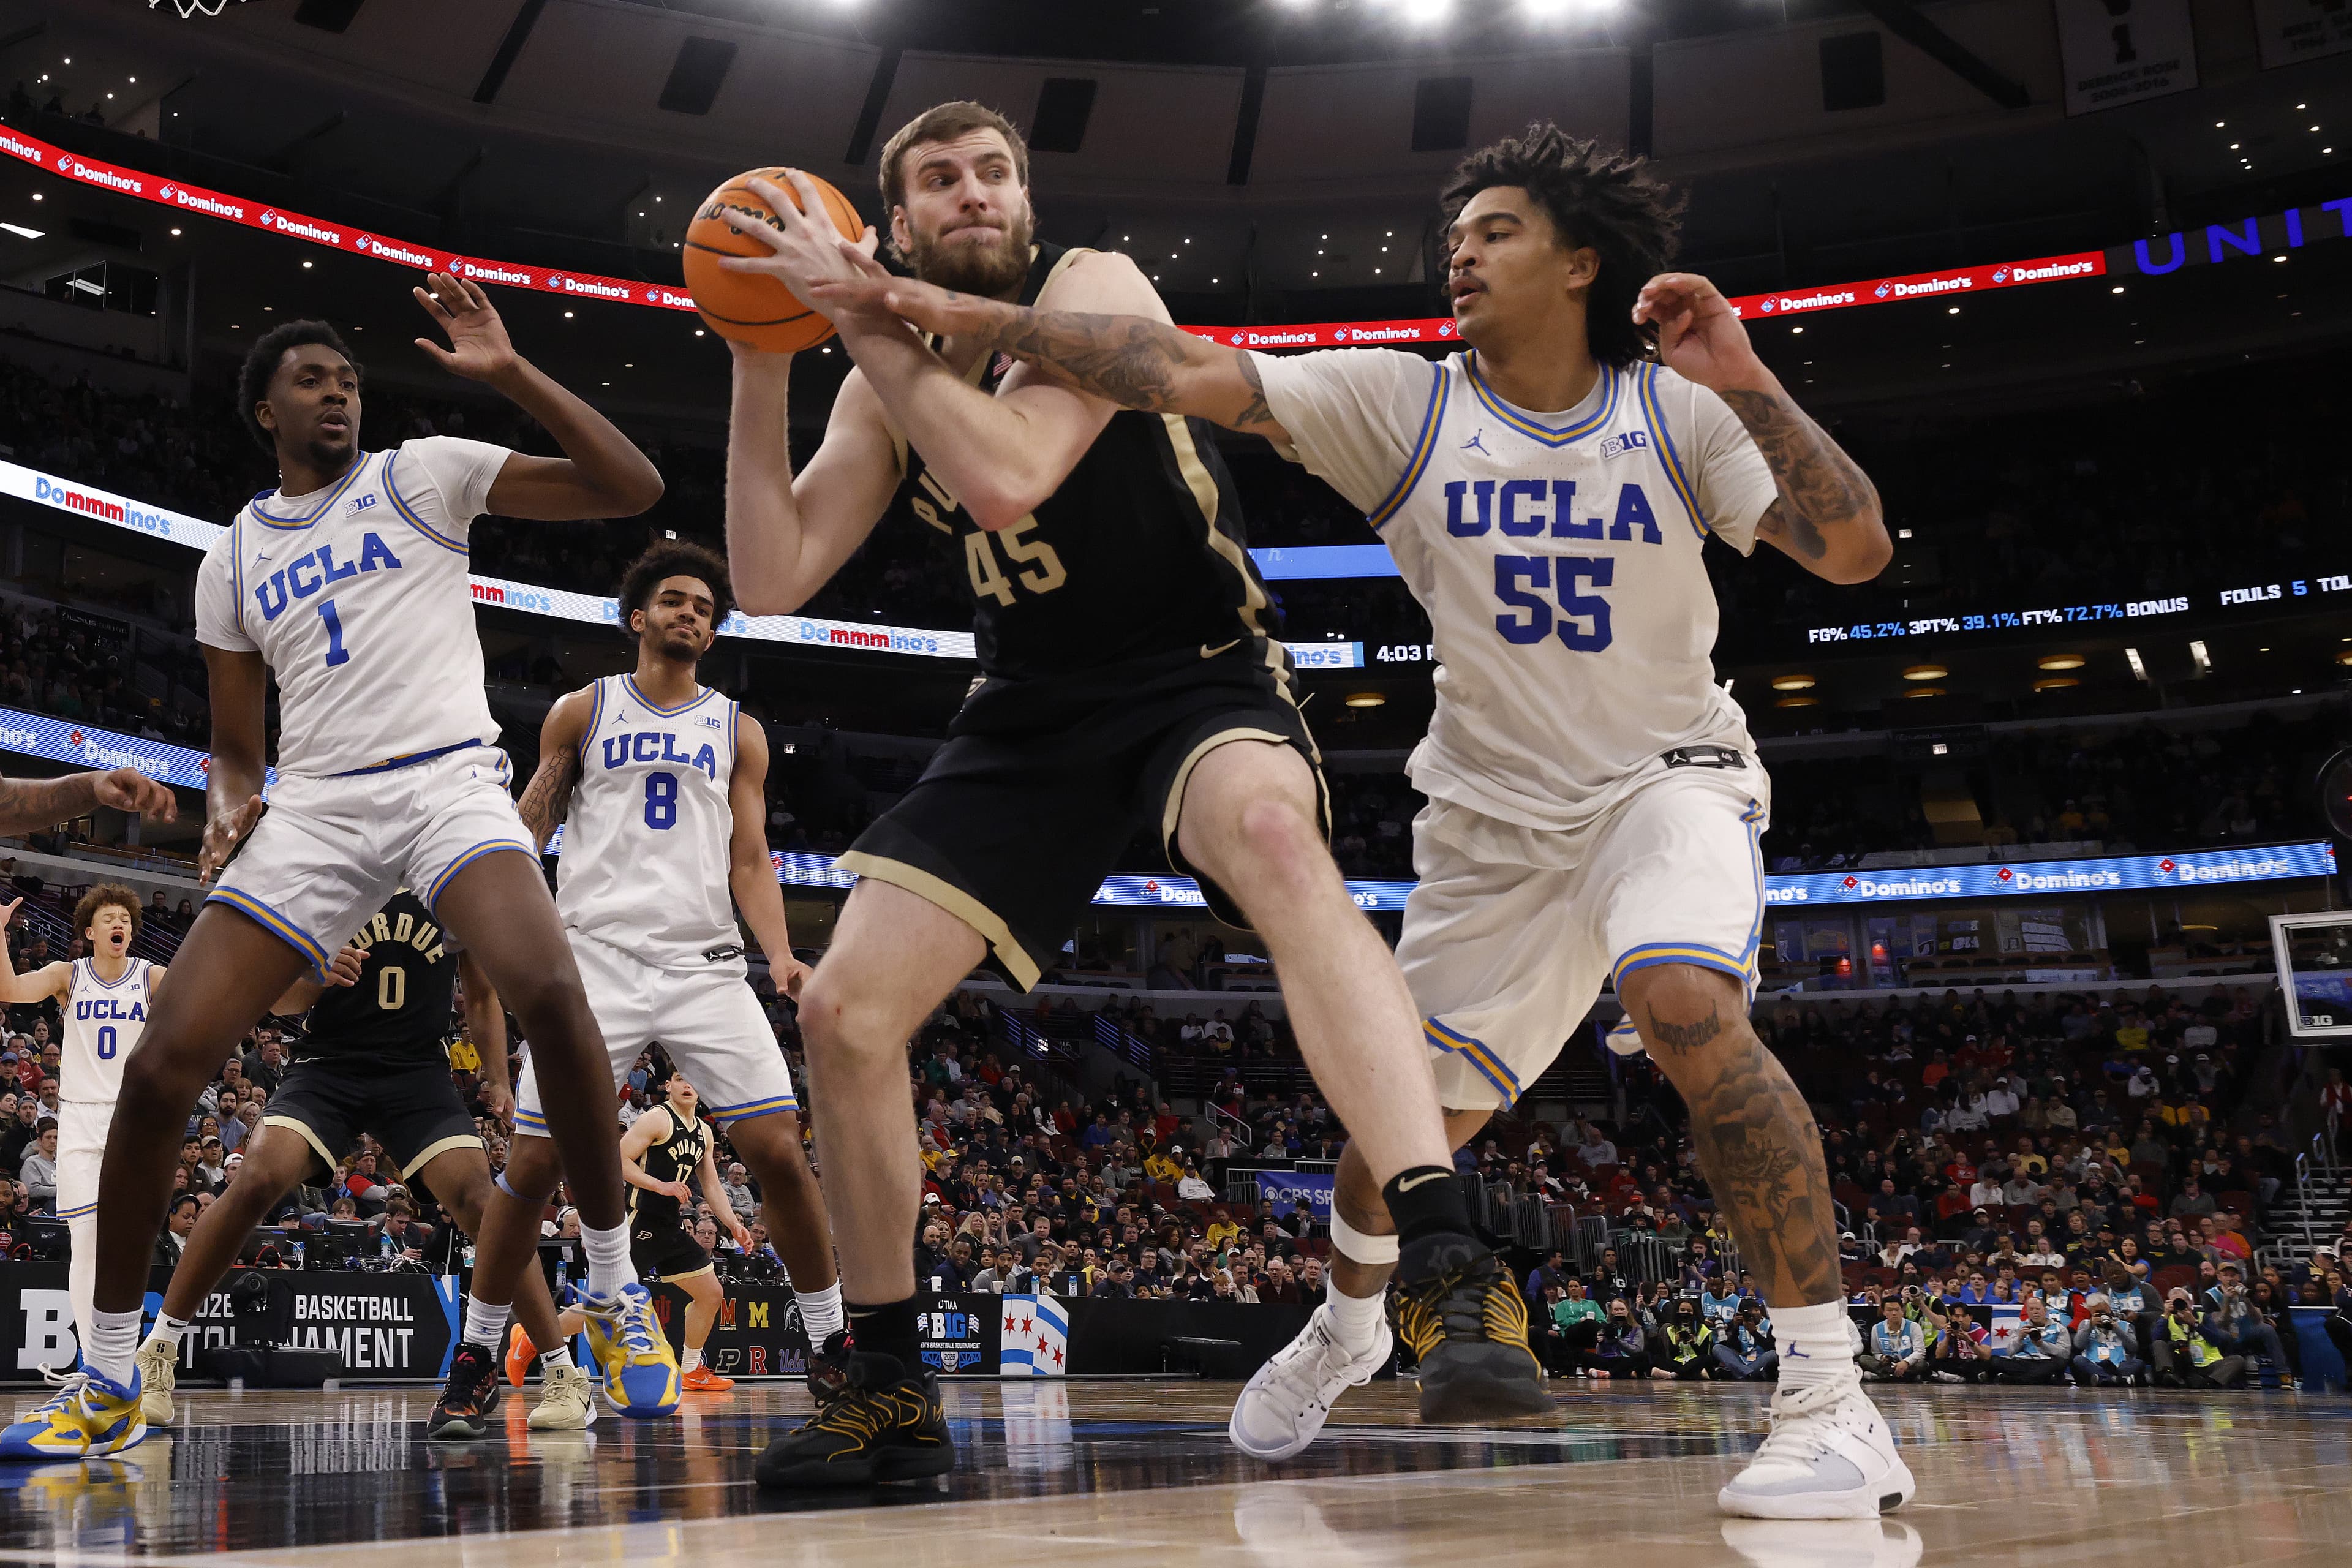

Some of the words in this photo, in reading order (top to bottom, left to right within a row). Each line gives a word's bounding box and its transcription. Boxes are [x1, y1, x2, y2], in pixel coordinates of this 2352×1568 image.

[74, 162, 142, 193] Domino's
[178, 190, 243, 219] Domino's
[277, 216, 340, 244] Domino's
[372, 241, 432, 268] Domino's
[465, 263, 531, 285] Domino's
[2013, 260, 2094, 282] Domino's
[565, 277, 630, 299] Domino's
[1894, 276, 1972, 298] Domino's
[1780, 291, 1855, 311] Domino's
[1249, 332, 1317, 345] Domino's
[1352, 328, 1420, 341] Domino's
[35, 476, 172, 535] Dommmino's
[1444, 480, 1663, 545] UCLA
[964, 512, 1068, 608] 45
[255, 532, 402, 622] UCLA
[1494, 554, 1615, 653] 55
[2220, 584, 2282, 606] FOULS
[2292, 580, 2308, 596] 5
[1809, 627, 1848, 643] FG%
[1850, 622, 1905, 639] 45.2%
[1909, 617, 1960, 635] 3PT%
[1962, 612, 2020, 631] 39.1%
[2022, 609, 2063, 626] FT%
[2064, 603, 2124, 622] 72.7%
[2126, 596, 2189, 617] BONUS
[318, 599, 350, 668] 1
[800, 621, 938, 653] Dommmino's
[1376, 645, 1422, 662] 4:03
[85, 739, 170, 776] Domino's
[602, 731, 716, 783] UCLA
[644, 771, 678, 830] 8
[2016, 869, 2122, 890] Domino's
[2179, 858, 2289, 880] Domino's
[1861, 877, 1961, 899] Domino's
[351, 913, 445, 965] URDUE
[378, 966, 405, 1010] 0
[76, 1000, 146, 1022] UCLA
[97, 1025, 117, 1060] 0
[668, 1139, 704, 1166] PURDU
[676, 1163, 693, 1185] 17
[296, 1295, 414, 1321] BASKETBALL
[944, 1300, 957, 1310] TIAA
